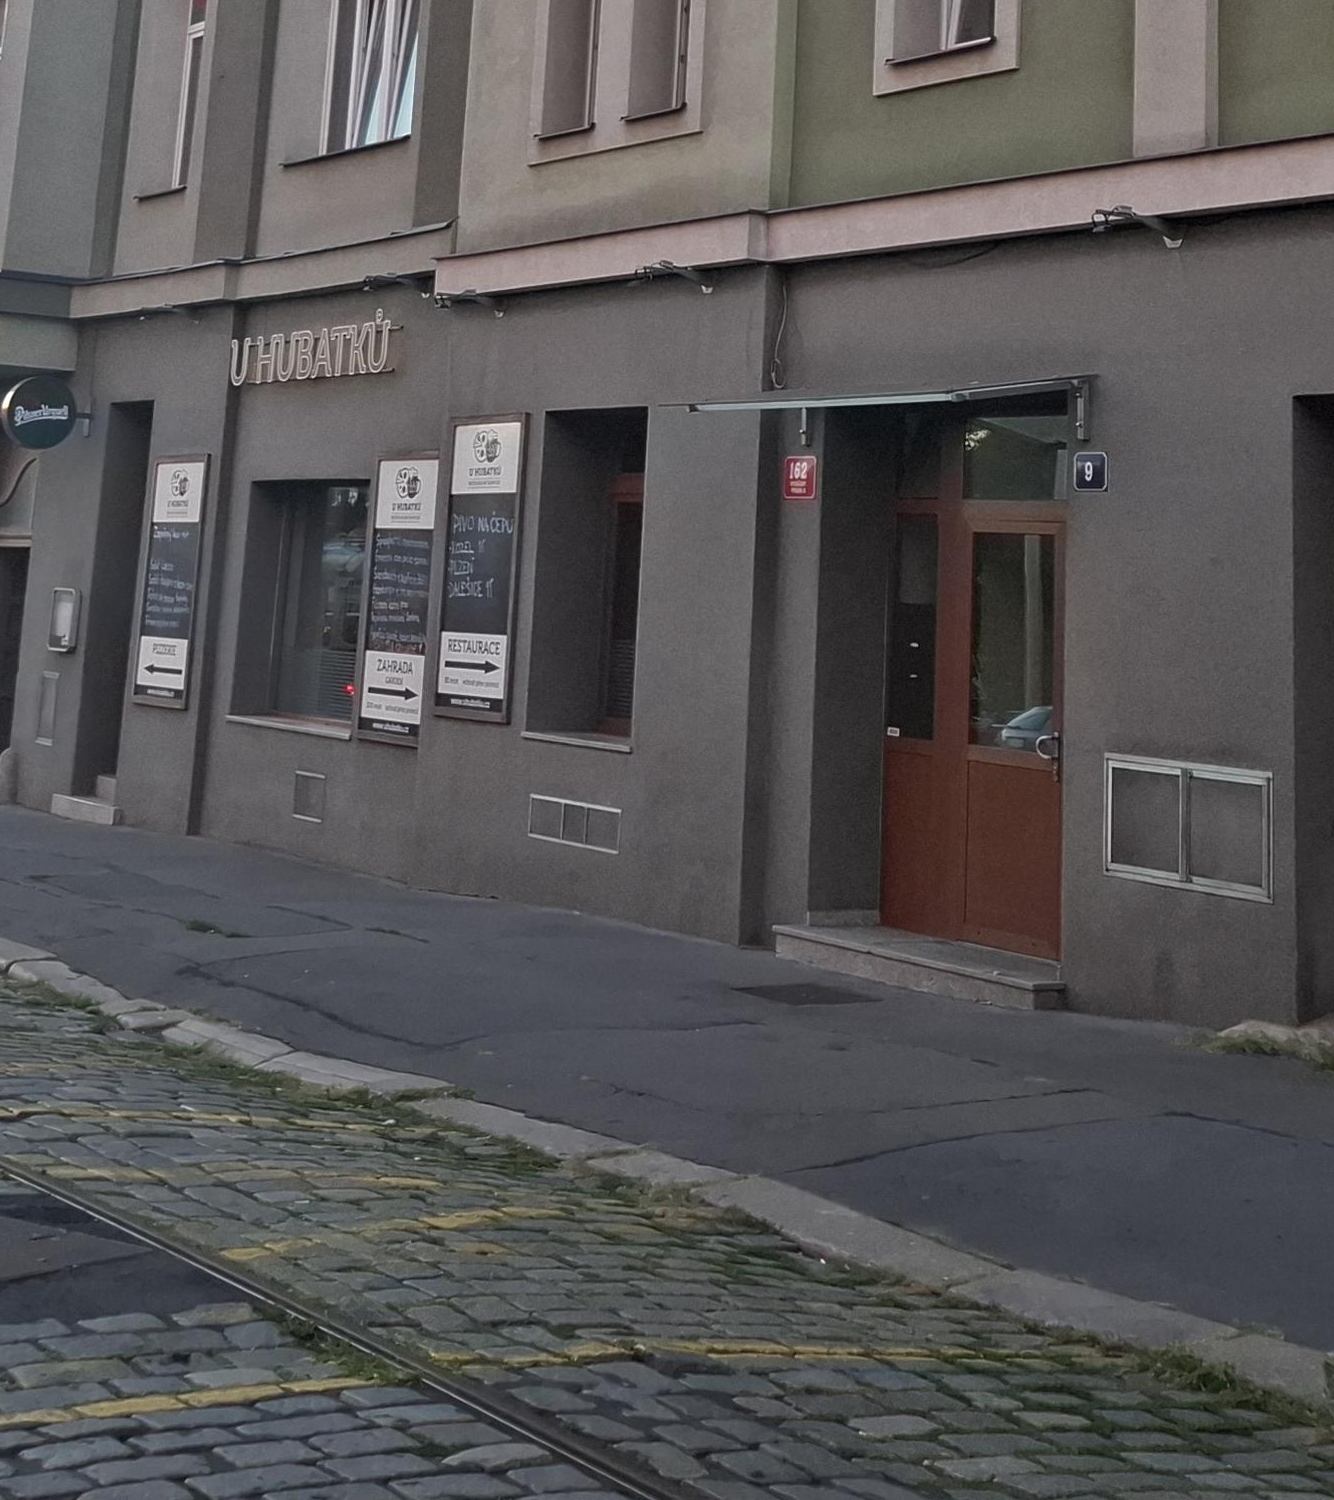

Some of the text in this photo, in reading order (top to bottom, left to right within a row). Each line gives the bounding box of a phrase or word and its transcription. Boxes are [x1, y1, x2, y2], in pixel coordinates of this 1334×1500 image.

[230, 308, 392, 387] U HUBATKŮ
[789, 461, 808, 480] 162
[1084, 461, 1093, 482] 9
[447, 638, 501, 656] RESTAURACE
[376, 658, 414, 675] ZAHRADA
